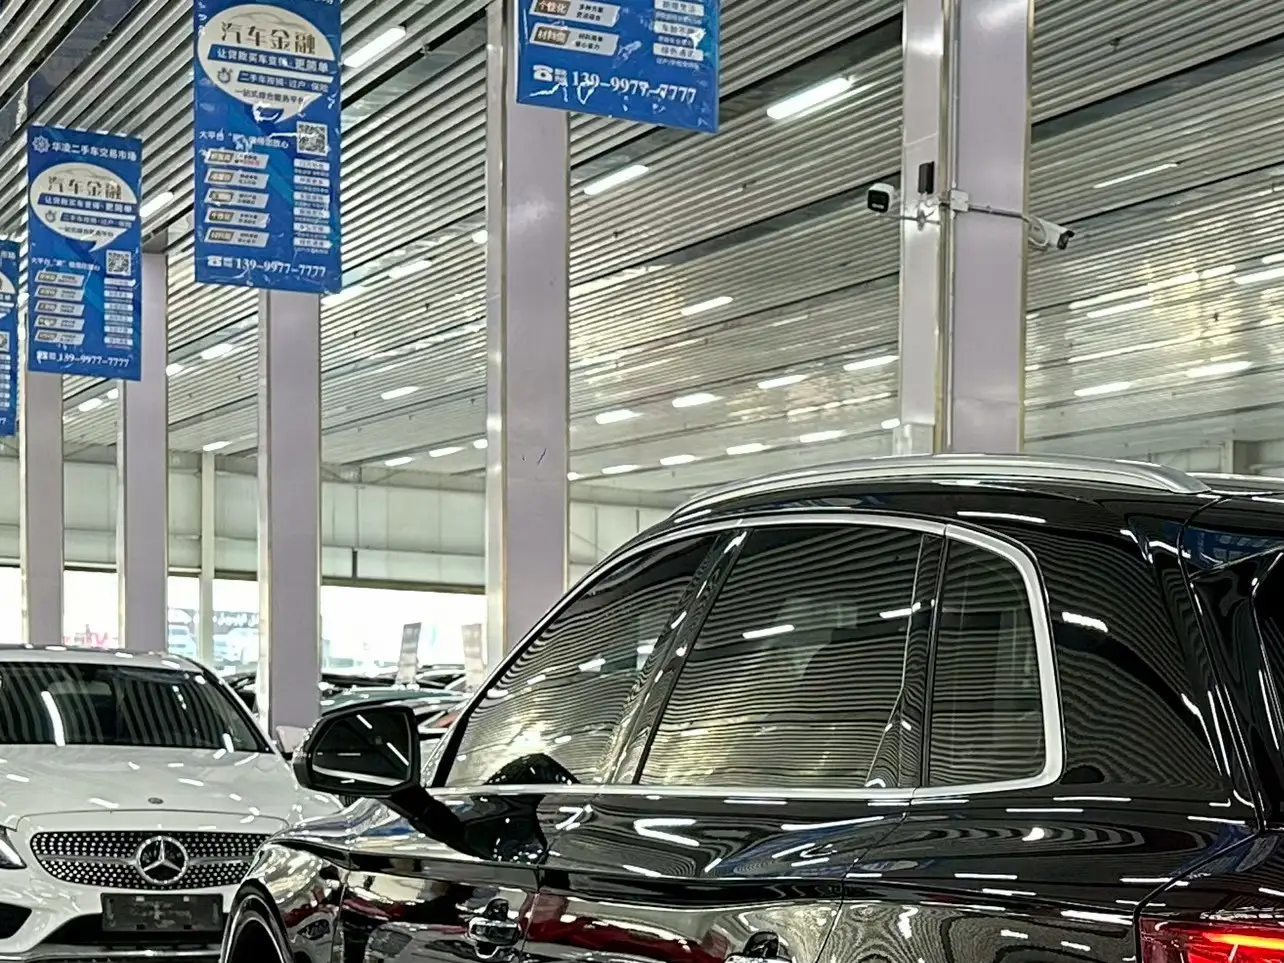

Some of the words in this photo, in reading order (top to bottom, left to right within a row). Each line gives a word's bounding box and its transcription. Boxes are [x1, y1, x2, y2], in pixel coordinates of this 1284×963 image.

[221, 21, 316, 54] 汽车金融
[571, 71, 697, 104] 139-9977-7777
[51, 141, 138, 162] 华凌二手车交易市场
[48, 175, 122, 200] 汽车金融
[236, 258, 327, 277] 139-9977-7777
[57, 353, 130, 368] 139-9977-7777
